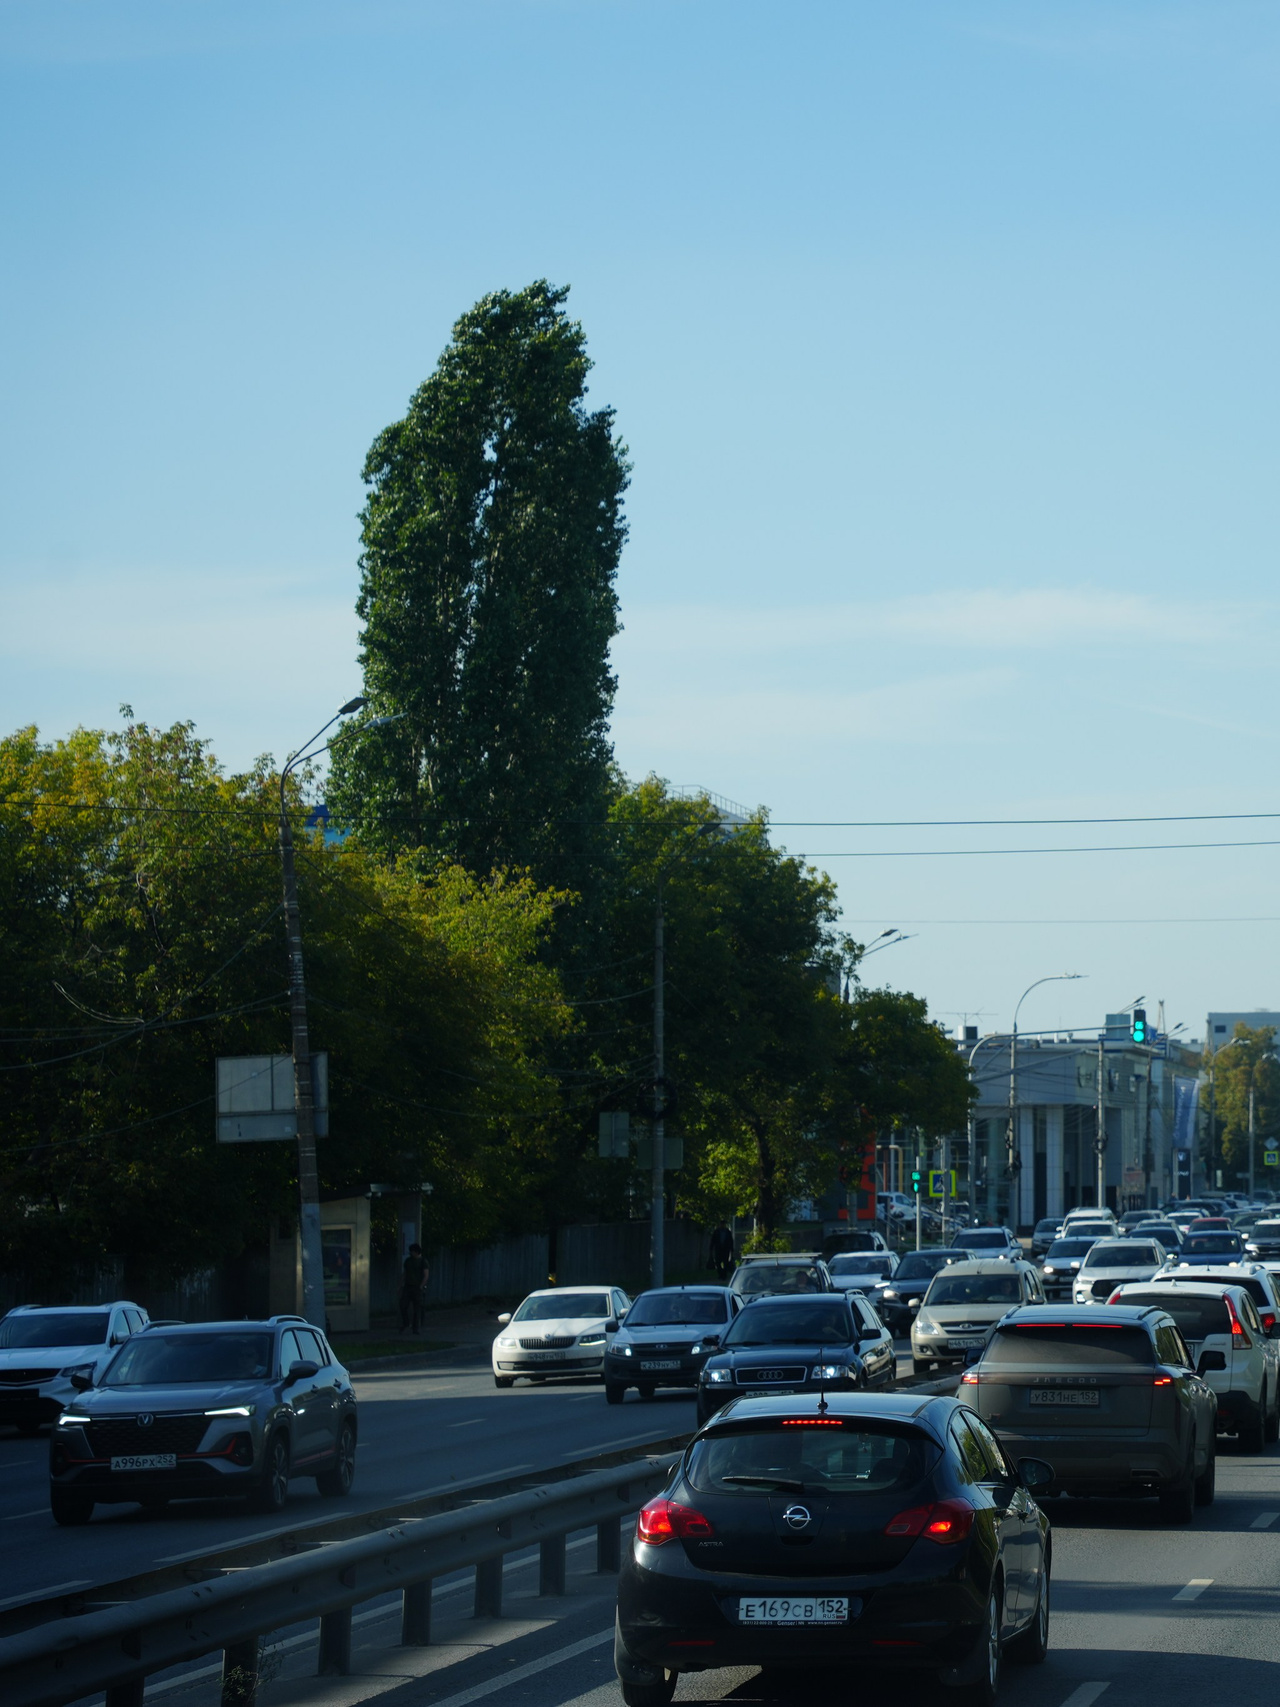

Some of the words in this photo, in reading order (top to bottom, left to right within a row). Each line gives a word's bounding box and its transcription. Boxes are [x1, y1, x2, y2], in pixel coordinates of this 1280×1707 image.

[1079, 1391, 1096, 1400] 152
[157, 1455, 174, 1464] 252
[745, 1600, 813, 1618] Е169СВ
[818, 1600, 844, 1613] 152
